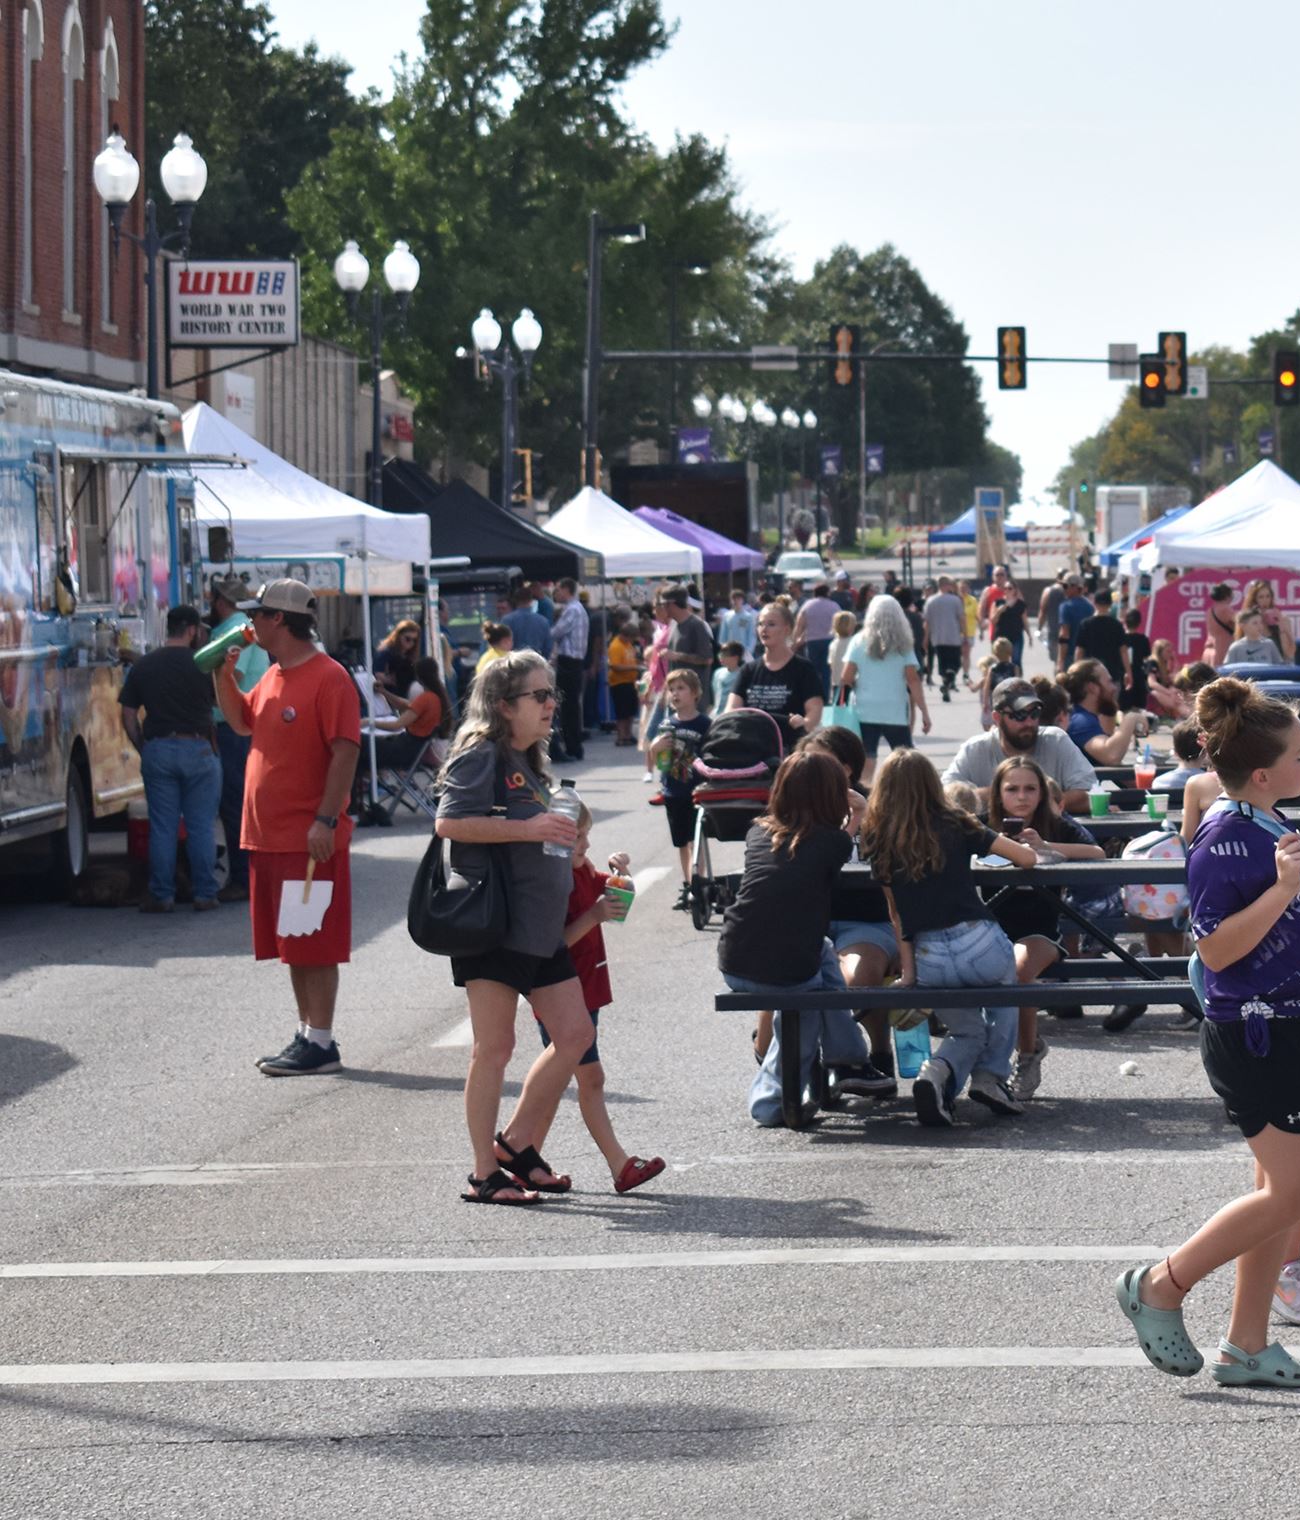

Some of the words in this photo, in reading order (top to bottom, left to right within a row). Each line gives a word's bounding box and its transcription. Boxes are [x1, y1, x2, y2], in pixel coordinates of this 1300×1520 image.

[179, 271, 286, 295] WWII
[180, 303, 222, 317] WORLD
[228, 303, 255, 317] WAR
[260, 303, 287, 317] TWO
[180, 321, 232, 335] HISTORY
[238, 321, 286, 335] CENTER
